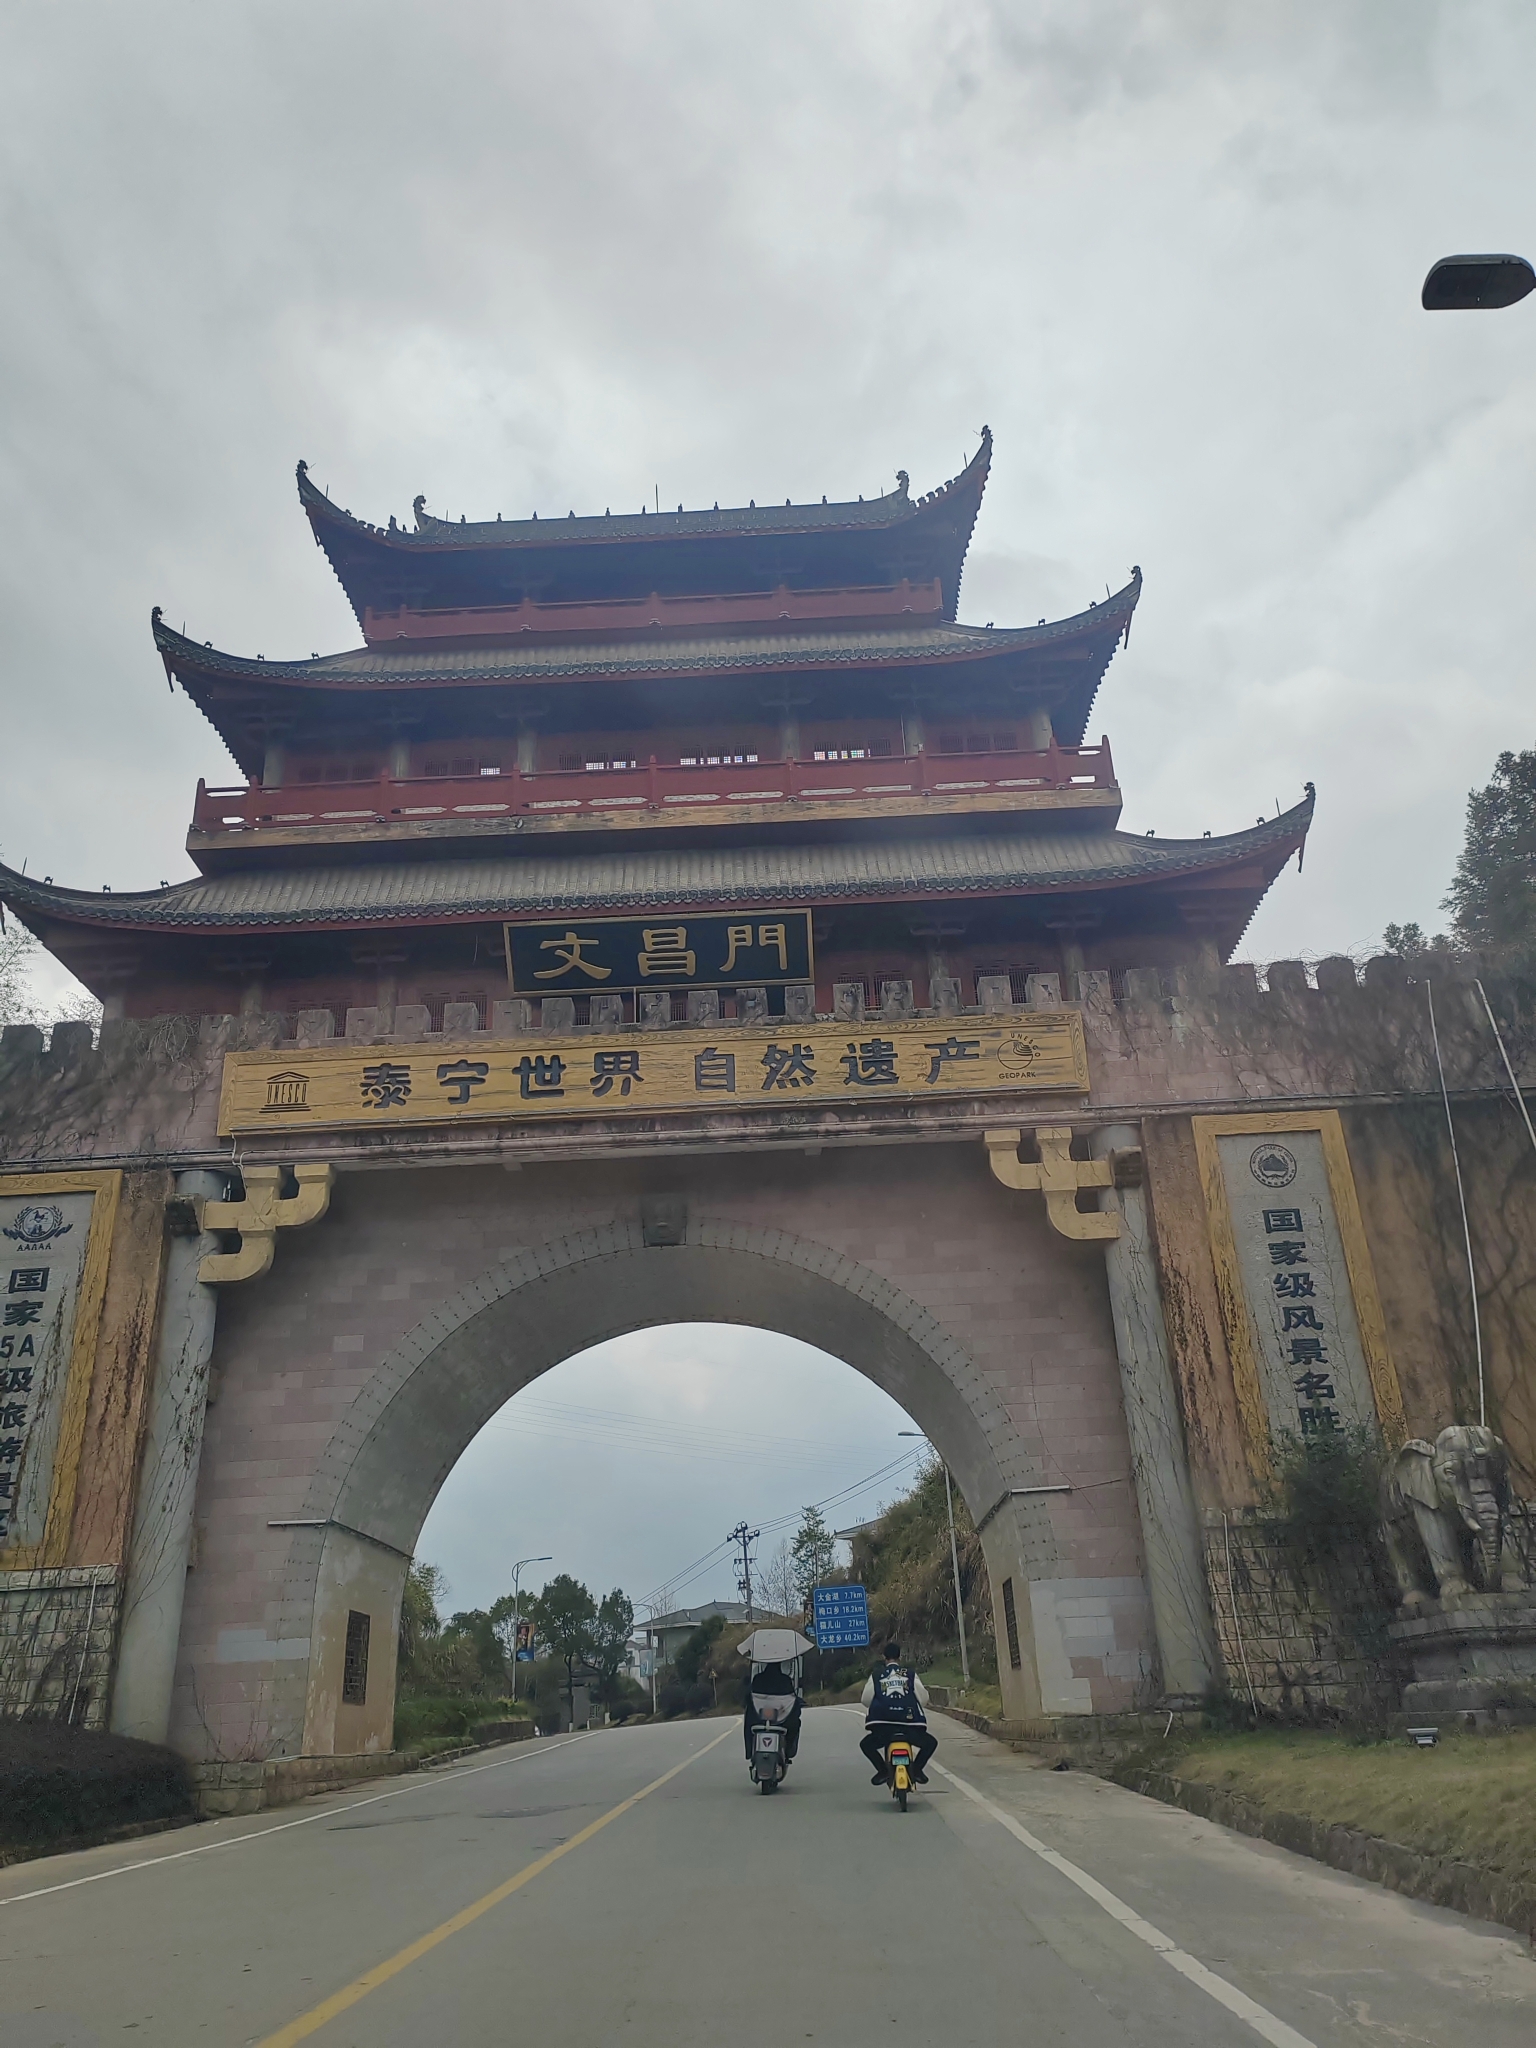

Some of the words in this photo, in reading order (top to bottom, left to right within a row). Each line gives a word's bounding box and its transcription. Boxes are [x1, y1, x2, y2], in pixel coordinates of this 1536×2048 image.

[533, 923, 788, 980] 文昌門
[1010, 1032, 1041, 1058] UNESCO
[360, 1036, 982, 1110] 泰宁世界自然遗产
[998, 1071, 1037, 1080] GEOPARK
[266, 1082, 307, 1104] UNESCO
[16, 1242, 52, 1252] AAAAA
[1262, 1207, 1345, 1436] 国家级风景名胜
[818, 1592, 839, 1601] 大金湖
[849, 1619, 865, 1627] 27km
